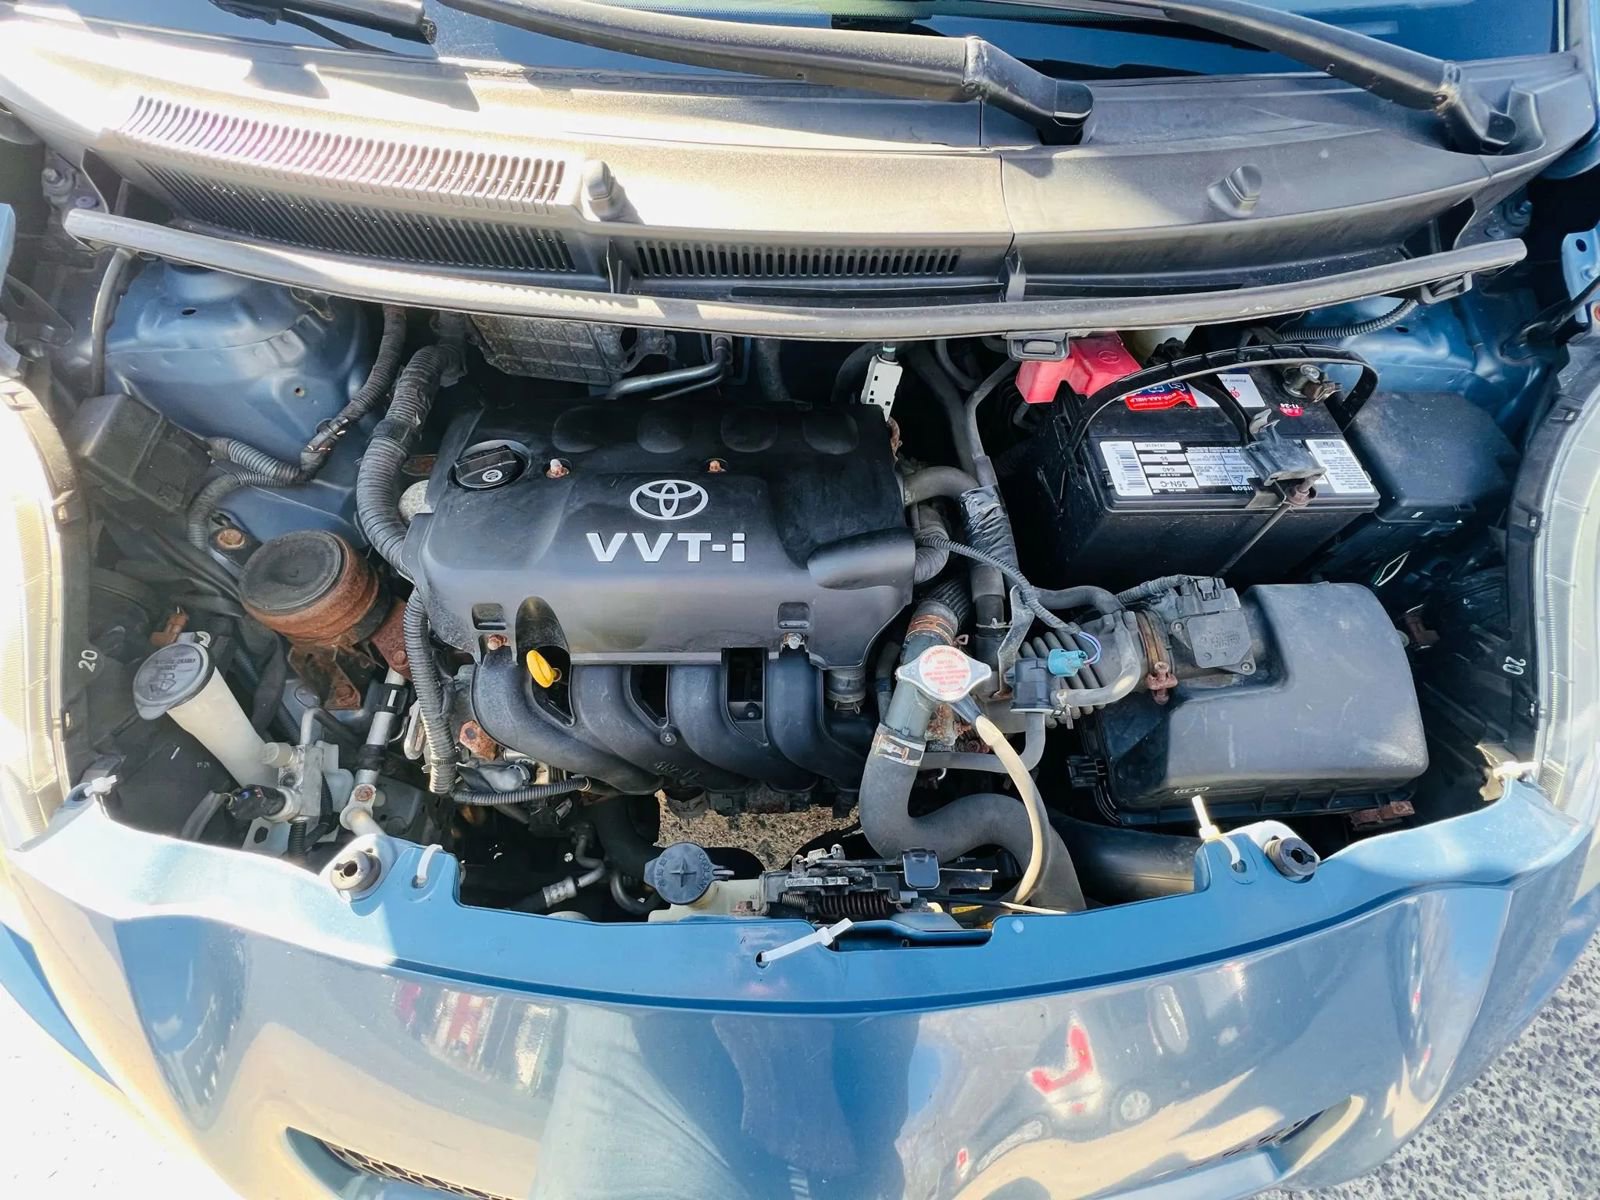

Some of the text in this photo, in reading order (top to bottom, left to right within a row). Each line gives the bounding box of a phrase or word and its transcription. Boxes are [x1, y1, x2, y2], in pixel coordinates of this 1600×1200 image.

[585, 532, 746, 563] VVT-i
[78, 650, 98, 672] 20
[1502, 656, 1526, 675] 20
